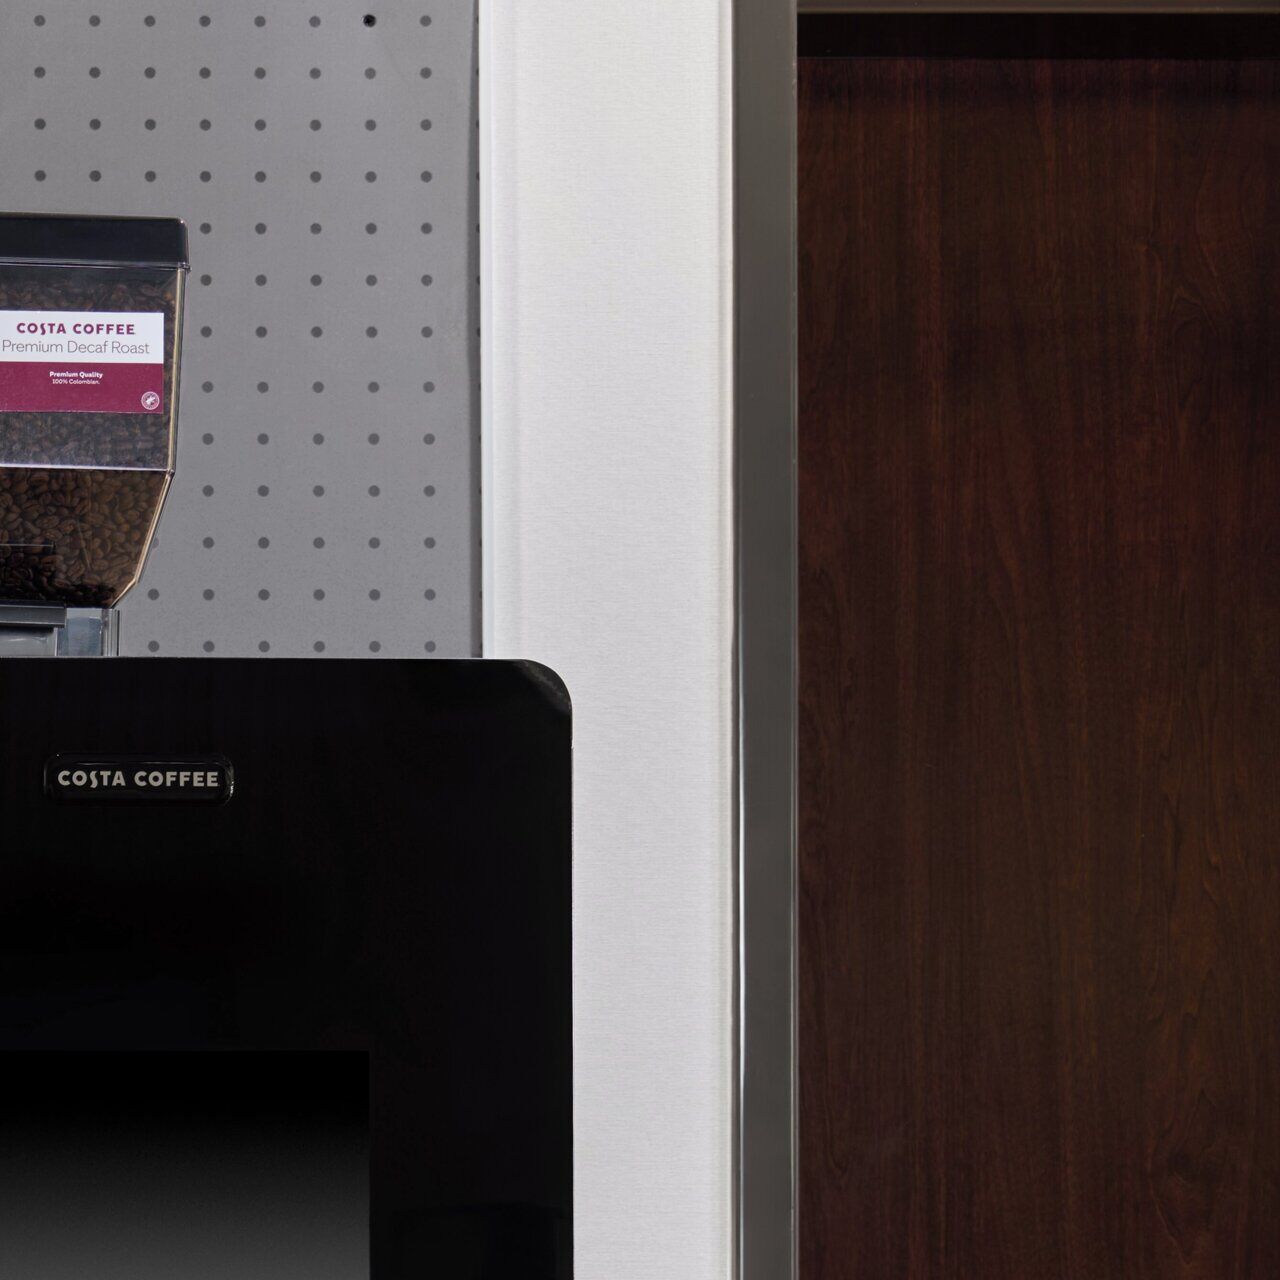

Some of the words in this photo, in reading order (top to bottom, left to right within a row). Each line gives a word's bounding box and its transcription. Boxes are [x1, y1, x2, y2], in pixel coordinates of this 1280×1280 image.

[17, 323, 66, 335] COSTA
[73, 324, 135, 335] COFFEE
[2, 340, 63, 352] Premium
[68, 341, 108, 353] Decaf
[112, 342, 149, 354] Roast
[58, 770, 126, 788] COSTA
[134, 771, 218, 787] COFFEE
